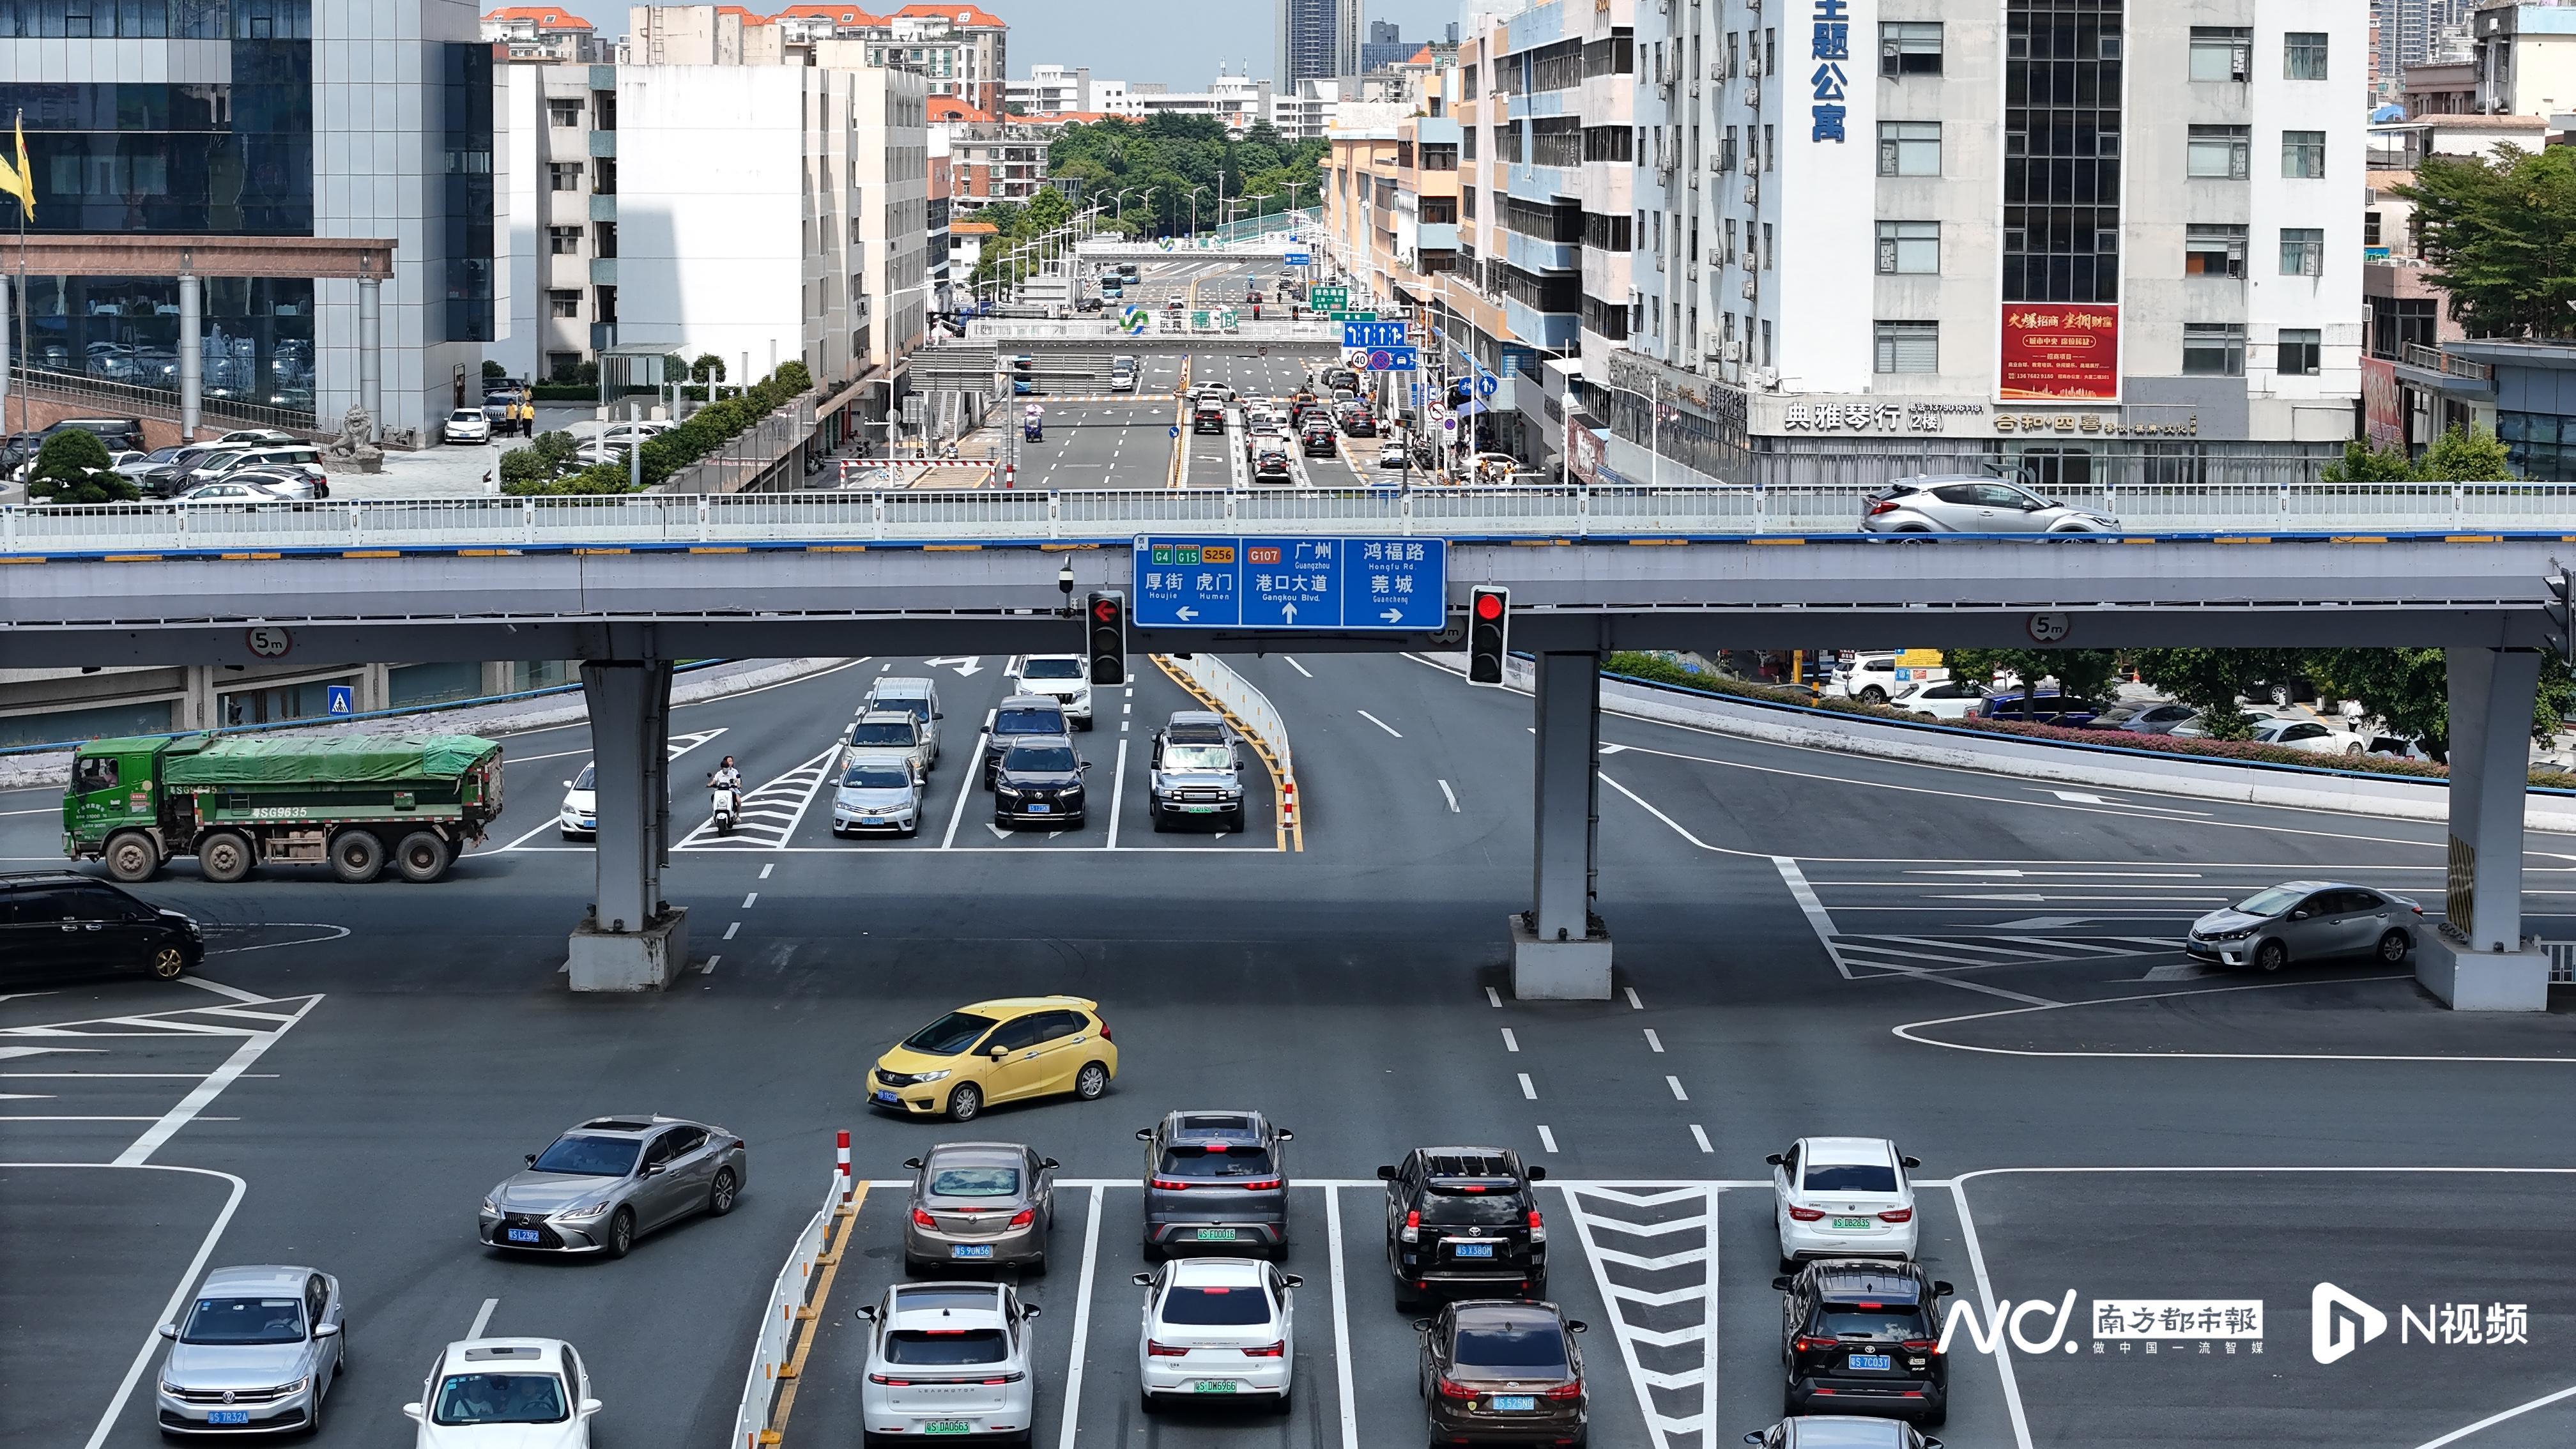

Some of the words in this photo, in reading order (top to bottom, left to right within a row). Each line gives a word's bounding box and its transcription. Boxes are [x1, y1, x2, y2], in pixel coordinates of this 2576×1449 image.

[1354, 356, 1365, 365] 40
[1785, 401, 1901, 430] 典雅琴行
[1156, 551, 1169, 562] G4
[1179, 551, 1197, 562] G15
[1204, 550, 1232, 560] S256
[1251, 551, 1278, 560] G107
[1294, 541, 1332, 560] 广州
[1363, 542, 1425, 561] 鸿福路
[1295, 562, 1330, 571] Guangzhou
[1368, 563, 1399, 572] Hongfu
[1145, 572, 1183, 591] 厚街
[1196, 572, 1232, 591] 虎门
[1255, 574, 1328, 592] 港口大道
[1371, 574, 1413, 594] 莞城
[1149, 592, 1177, 601] Houjie
[1262, 594, 1297, 602] Gangkou
[1373, 595, 1409, 604] Guancheng
[2037, 617, 2062, 633] 5m
[256, 632, 282, 648] 5m
